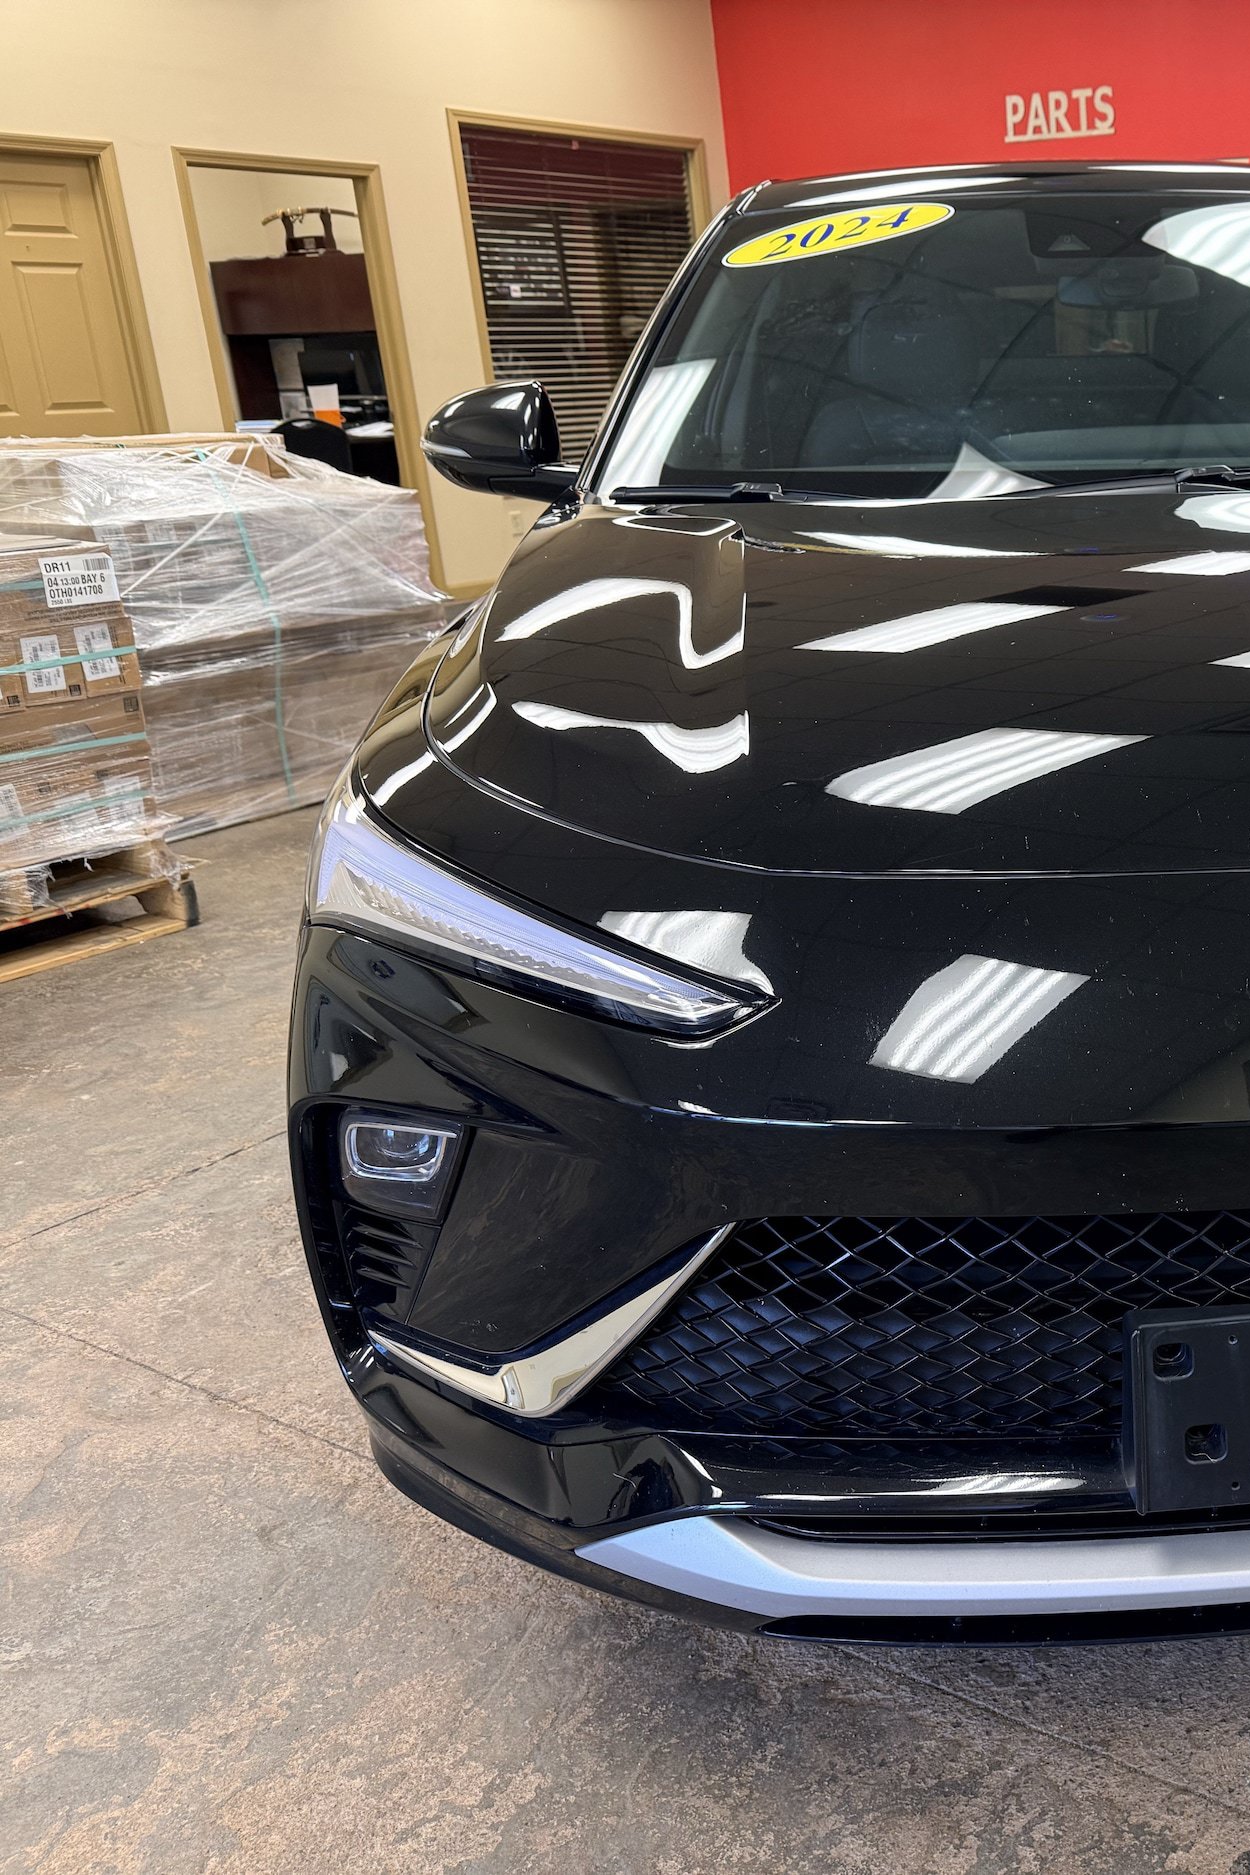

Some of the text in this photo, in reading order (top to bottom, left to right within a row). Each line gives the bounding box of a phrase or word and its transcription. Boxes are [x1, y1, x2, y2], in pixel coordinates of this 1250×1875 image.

[1005, 85, 1115, 141] PARTS
[760, 207, 913, 261] 2024
[43, 561, 71, 573] DR11
[47, 573, 106, 588] 04 13:00 BAY 6
